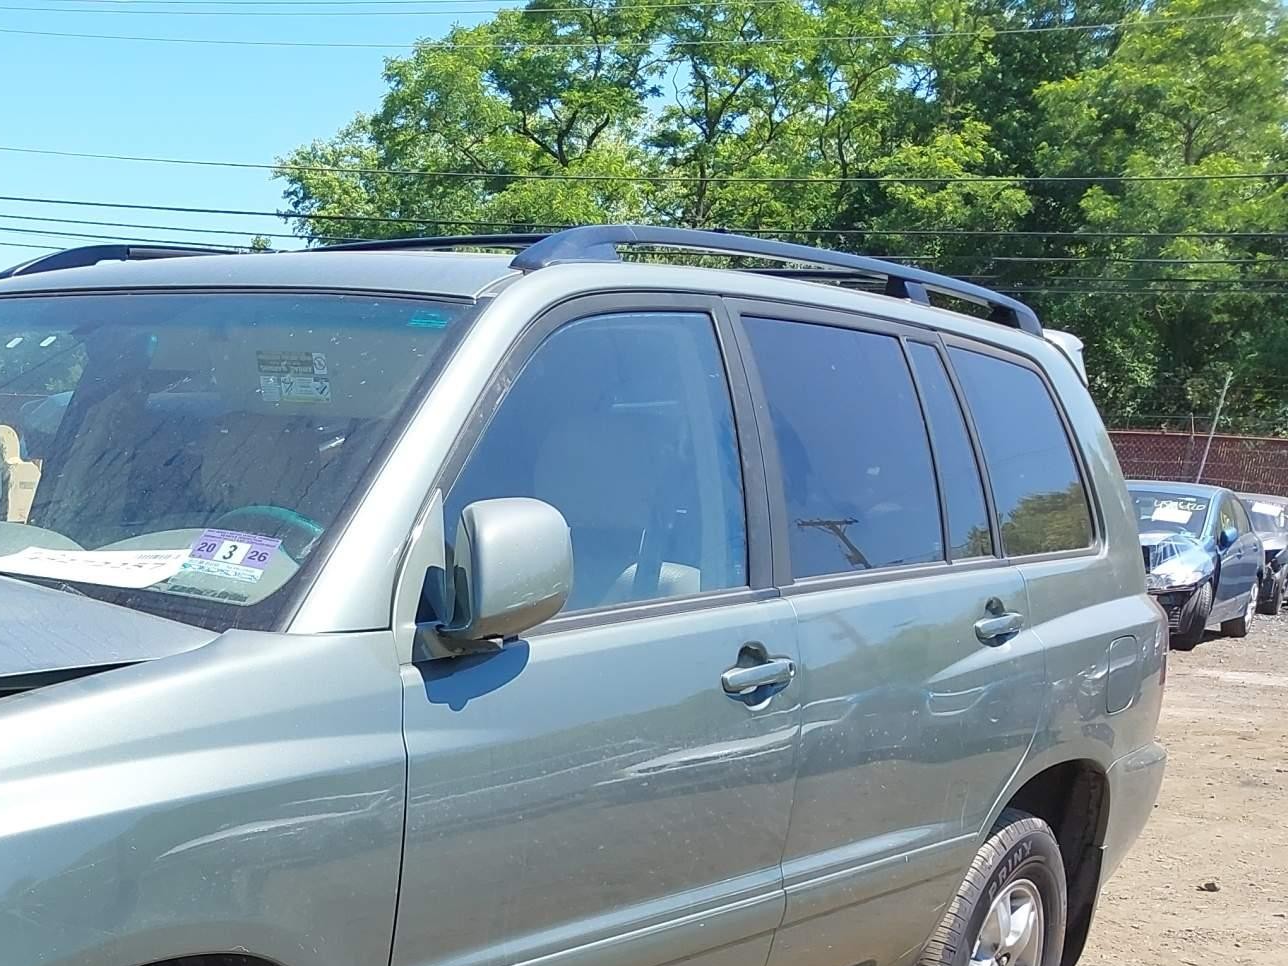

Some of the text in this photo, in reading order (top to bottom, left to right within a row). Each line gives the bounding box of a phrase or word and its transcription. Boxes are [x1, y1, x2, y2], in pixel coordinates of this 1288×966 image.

[197, 542, 269, 562] 20 3 26
